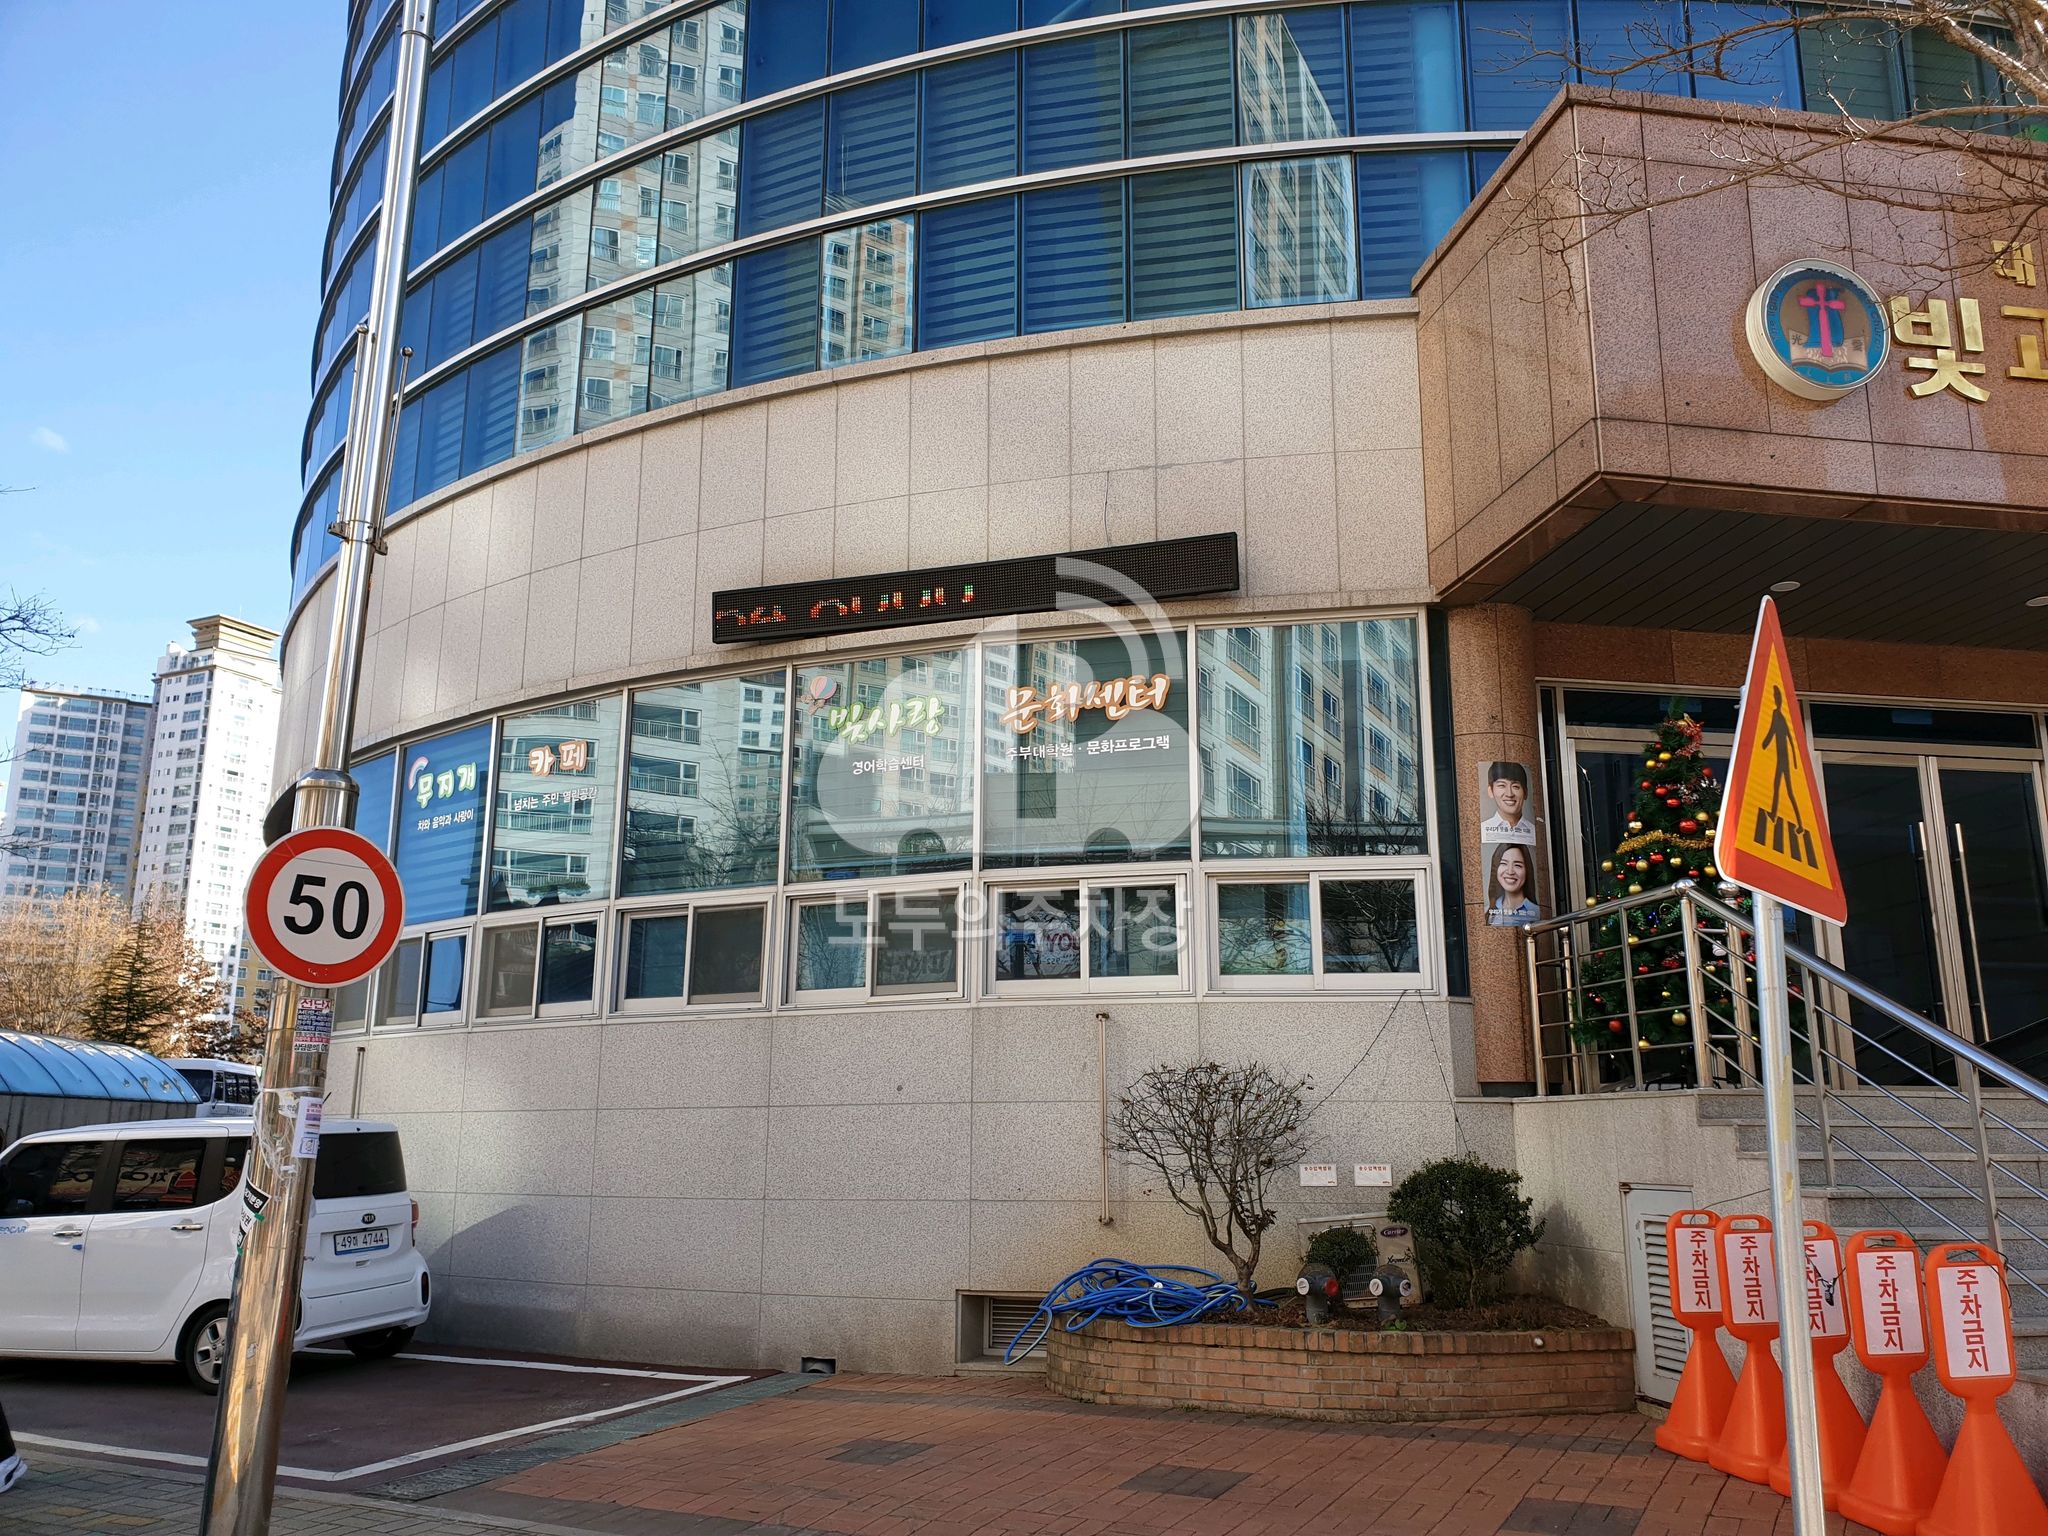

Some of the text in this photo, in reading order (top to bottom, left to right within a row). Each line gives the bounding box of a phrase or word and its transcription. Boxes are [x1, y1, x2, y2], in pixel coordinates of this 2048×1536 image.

[828, 694, 945, 745] 빛사랑
[1001, 674, 1171, 734] 문화센터
[529, 740, 588, 777] 카페
[416, 762, 477, 809] 무지개
[514, 797, 540, 811] 넘치는
[542, 793, 559, 806] 주민
[432, 815, 452, 829] 음악과
[453, 809, 474, 823] 사랑이
[284, 874, 369, 940] 50
[362, 1232, 384, 1246] 4744
[363, 1214, 375, 1223] KIA
[1690, 1230, 1712, 1309] 주차금지
[1740, 1236, 1765, 1320] 주차금지
[1876, 1256, 1904, 1351] 주차금지
[1957, 1269, 1989, 1372] 주차금지
